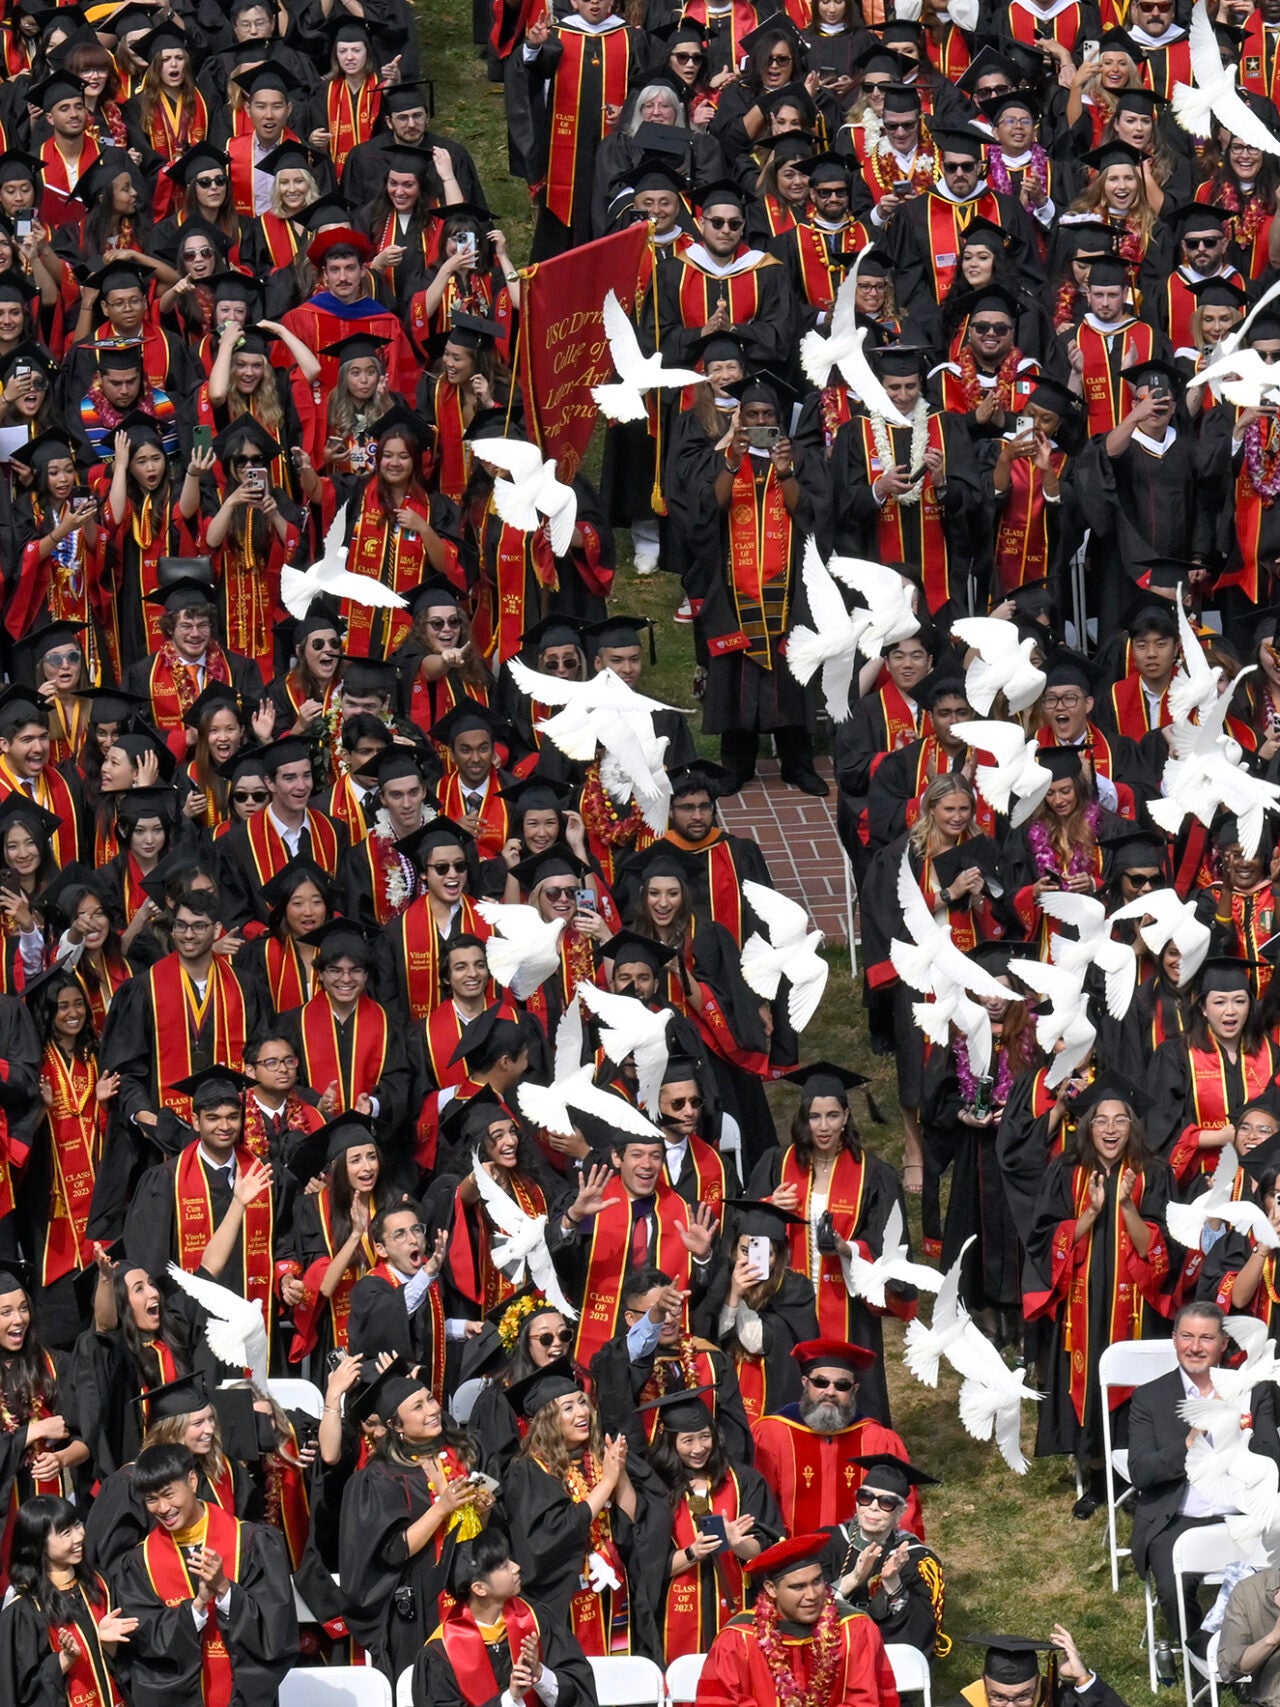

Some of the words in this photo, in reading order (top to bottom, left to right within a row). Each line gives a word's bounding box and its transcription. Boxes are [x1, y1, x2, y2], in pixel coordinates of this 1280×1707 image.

[555, 113, 575, 122] CLASS
[544, 316, 570, 350] USC
[589, 339, 610, 363] of
[1085, 376, 1107, 385] CLASS
[1092, 384, 1101, 392] OF
[1002, 527, 1024, 537] CLASS
[734, 542, 755, 550] CLASS
[357, 565, 378, 576] CLASS
[725, 636, 742, 647] USC
[709, 1009, 724, 1028] USC
[164, 1096, 189, 1106] CLASS
[1202, 1120, 1227, 1129] CLASS
[65, 1170, 91, 1183] CLASS
[73, 1180, 84, 1189] OF
[72, 1187, 90, 1198] 2023
[182, 1197, 204, 1205] Summa
[186, 1205, 201, 1213] Cum
[184, 1212, 204, 1221] Laude
[184, 1233, 206, 1241] Viterbi
[1057, 1232, 1068, 1252] USC
[253, 1276, 269, 1285] USC
[1219, 1274, 1235, 1296] USC
[589, 1292, 615, 1304] CLASS
[594, 1303, 605, 1312] OF
[589, 1311, 609, 1322] 2023
[672, 1584, 697, 1593] CLASS
[574, 1593, 597, 1605] CLASS
[678, 1594, 690, 1603] OF
[581, 1602, 592, 1612] OF
[674, 1604, 694, 1613] 2023
[579, 1610, 597, 1623] 2023
[207, 1641, 224, 1650] USC
[73, 1689, 97, 1705] CLASS
